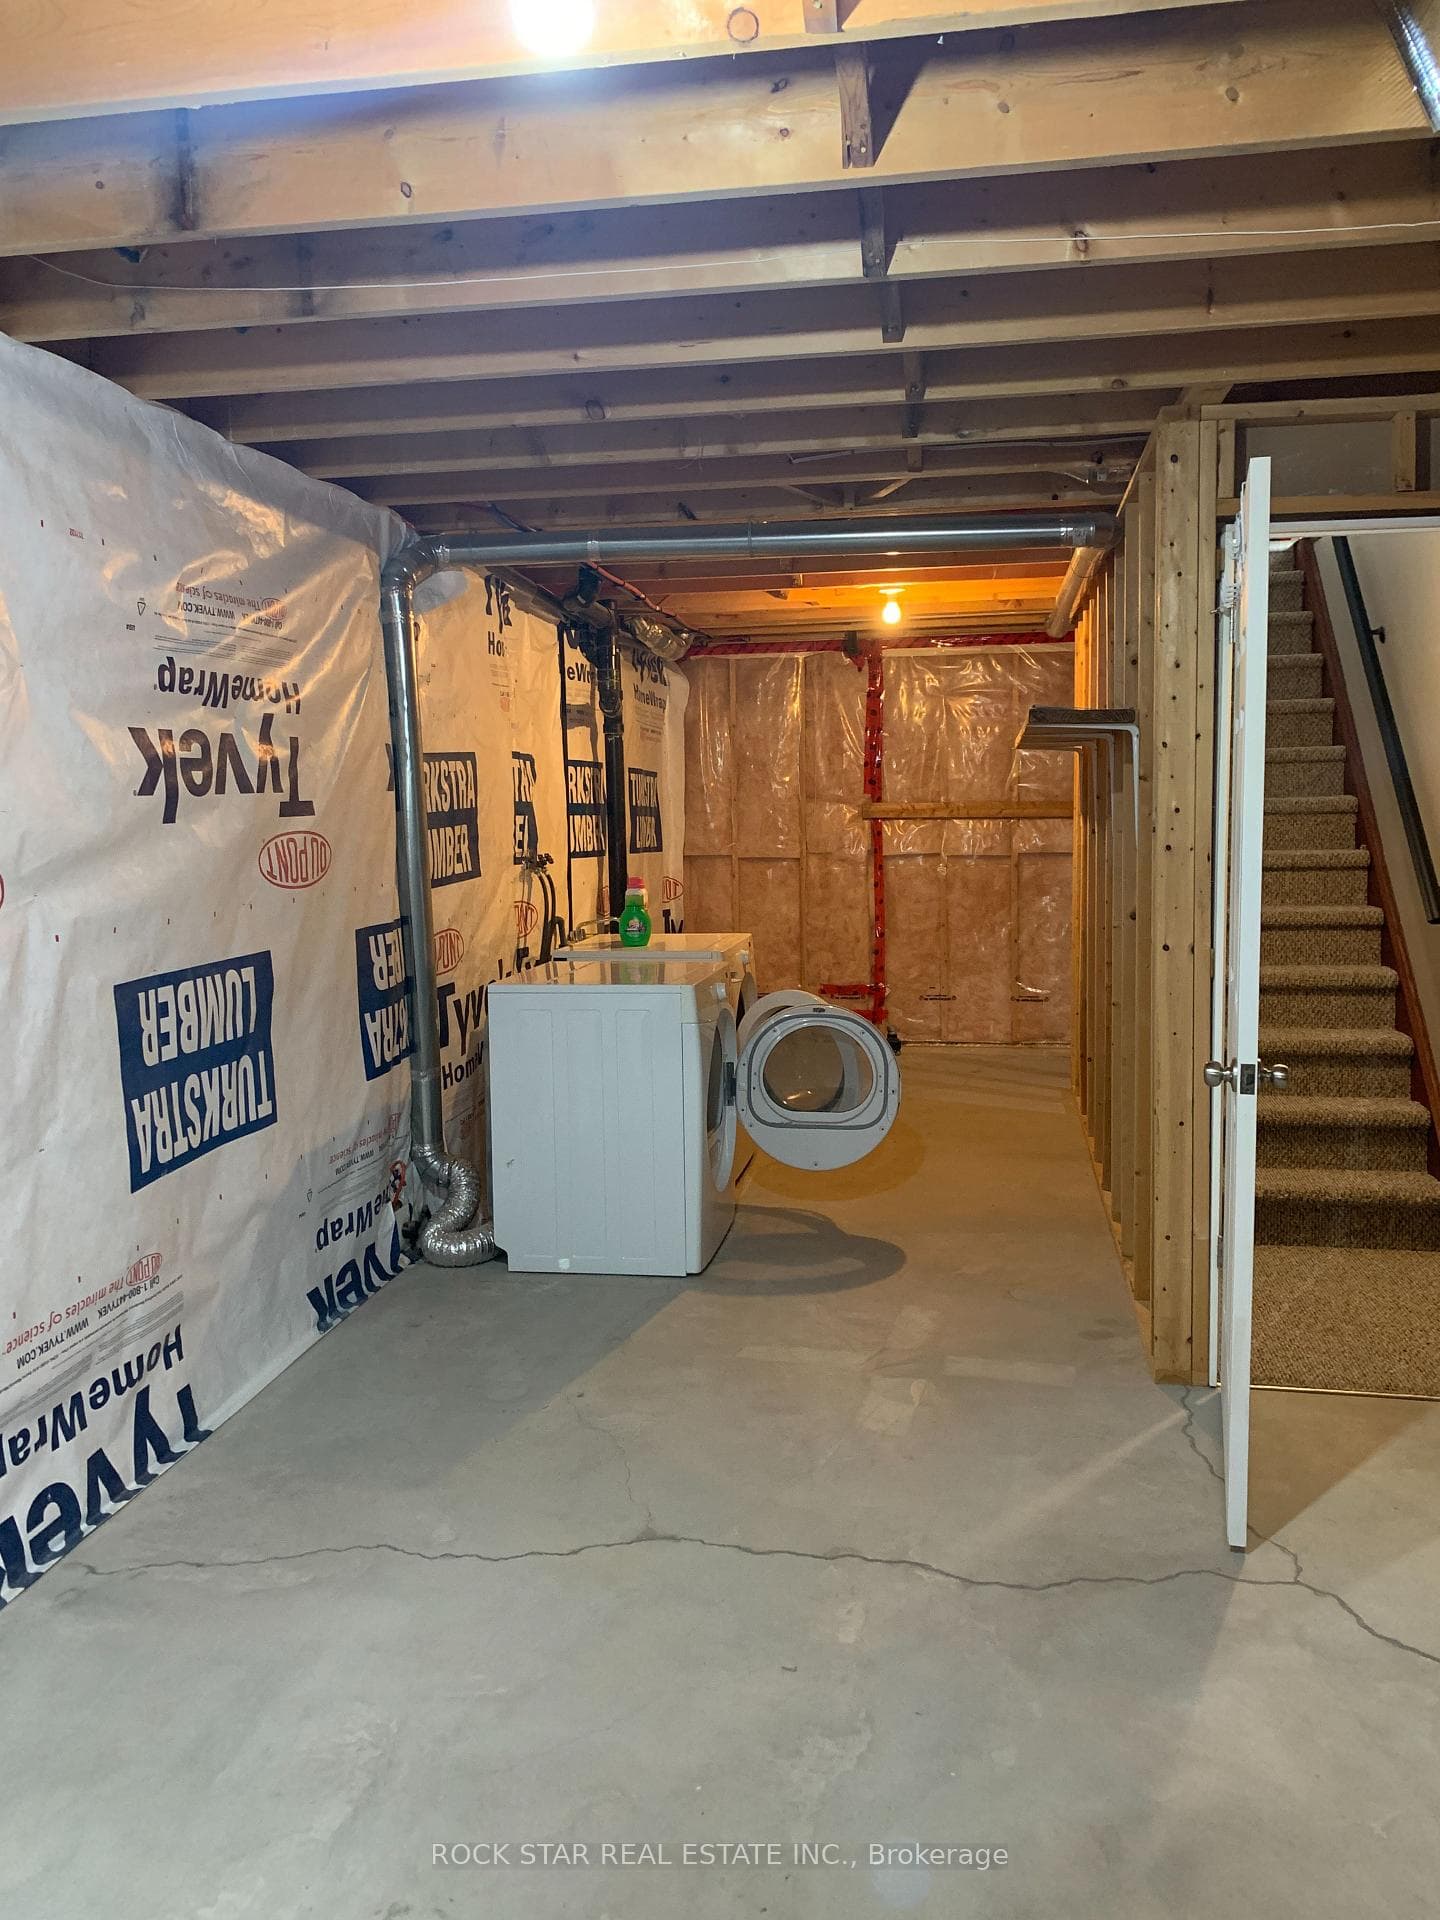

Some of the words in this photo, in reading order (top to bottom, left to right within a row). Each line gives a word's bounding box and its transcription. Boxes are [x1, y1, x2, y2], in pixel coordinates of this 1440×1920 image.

[156, 656, 302, 715] HomeWrap
[127, 712, 316, 824] Tyvek
[423, 760, 476, 812] RKSTRA
[137, 965, 257, 1067] LUMBER
[131, 1050, 273, 1174] TURKSTRA
[65, 1286, 108, 1320] miracles
[109, 1277, 125, 1295] The
[6, 1321, 46, 1354] science
[16, 1316, 90, 1370] WWW.TYVEK.COM
[48, 1310, 63, 1332] of
[0, 1323, 185, 1478] HomeWra
